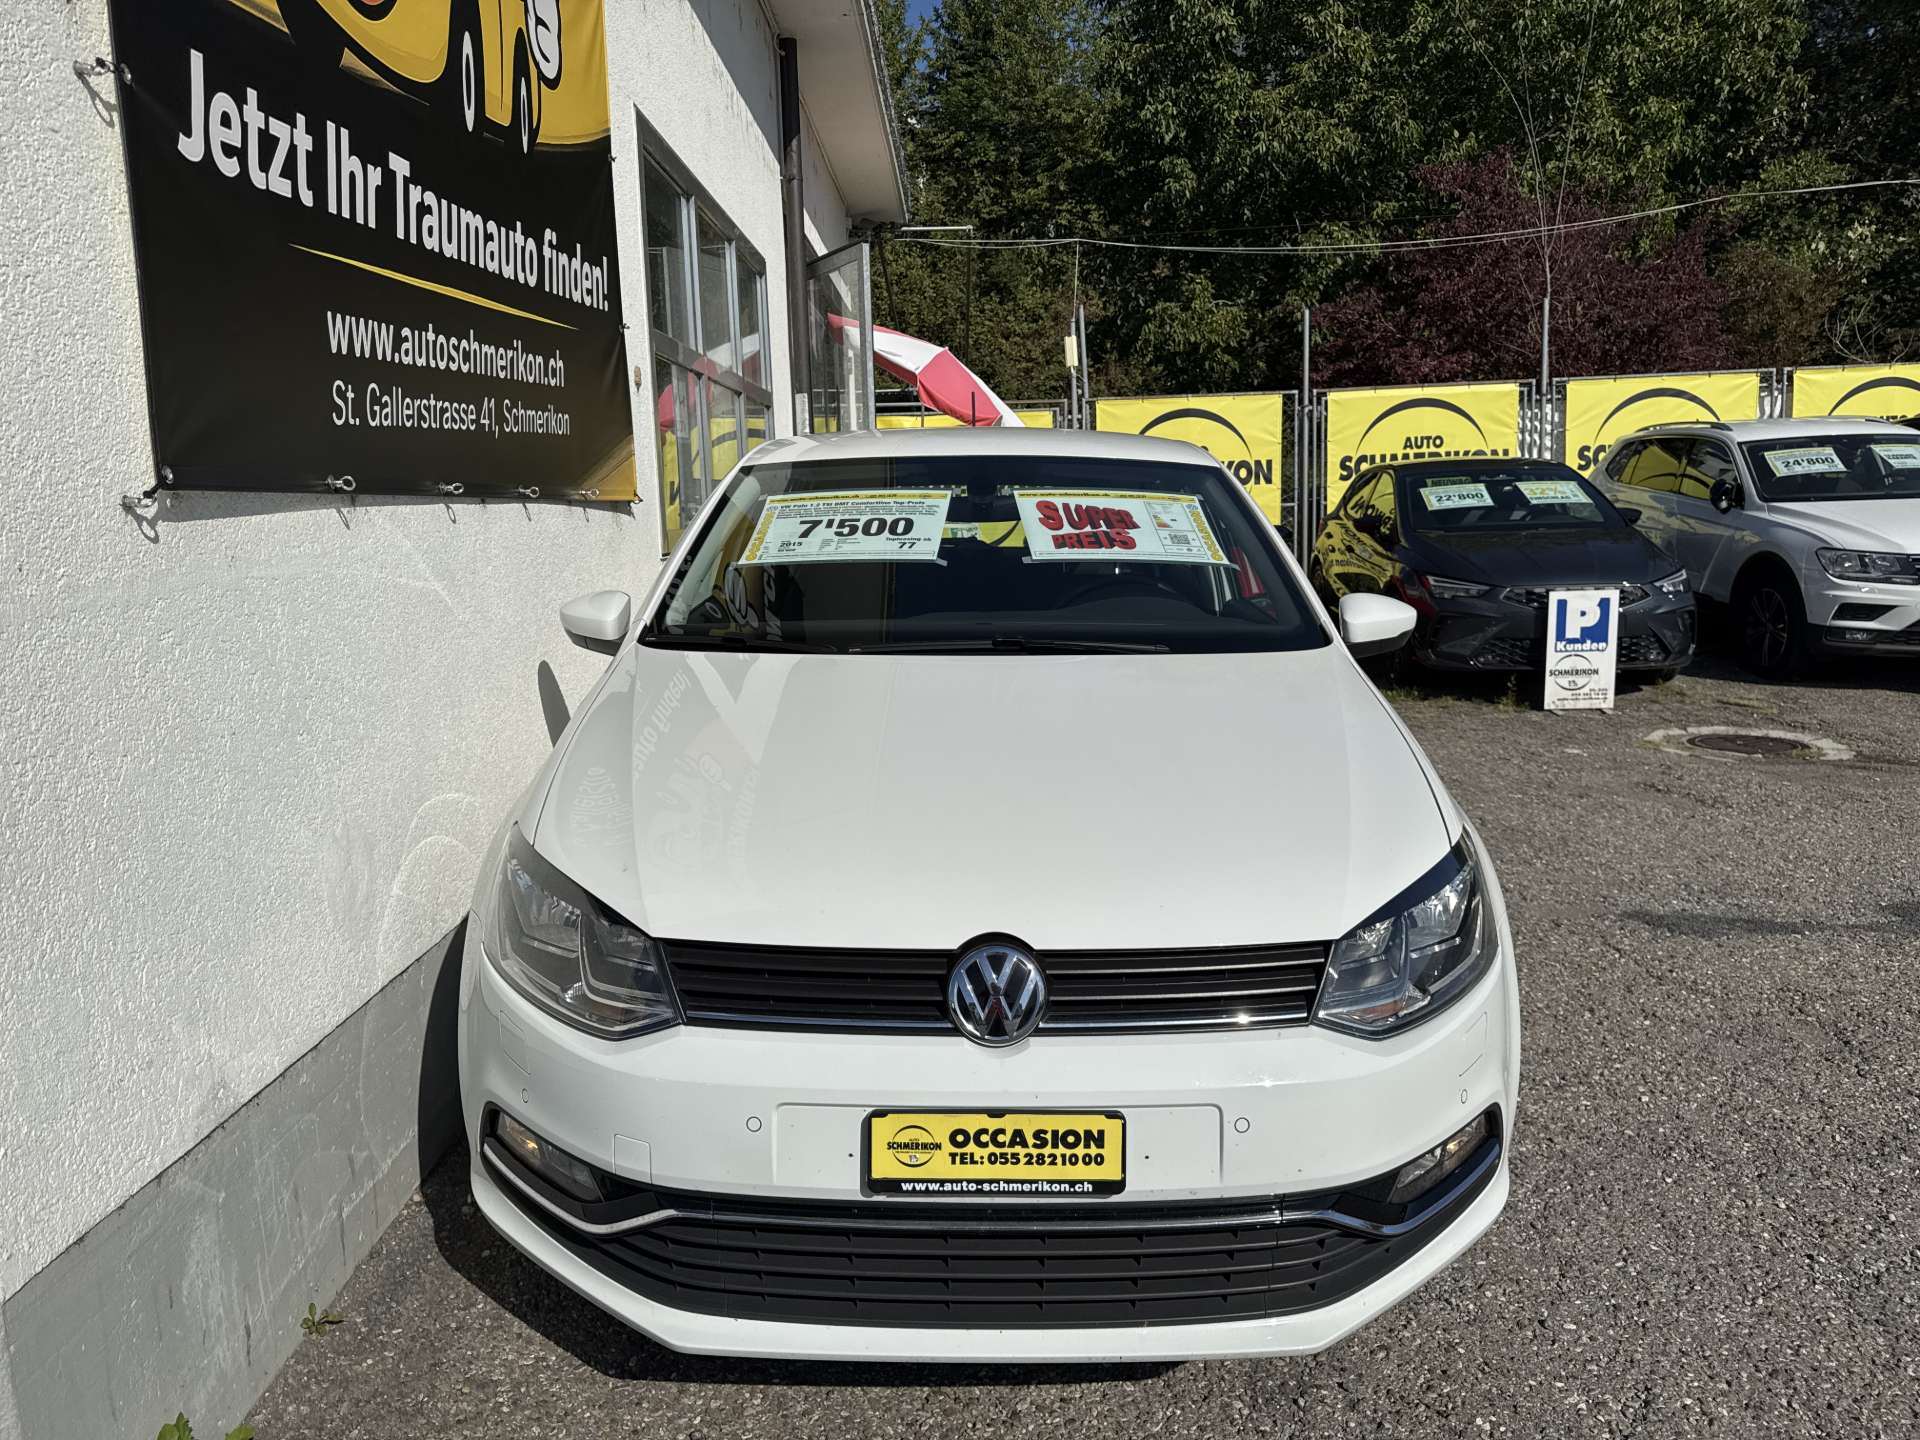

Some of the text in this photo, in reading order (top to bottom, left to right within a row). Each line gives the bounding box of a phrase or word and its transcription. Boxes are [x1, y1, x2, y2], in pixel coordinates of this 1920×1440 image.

[177, 48, 609, 312] Jetzt Ihr Traumauto finden!
[327, 310, 565, 388] www.autoschmerikon.ch
[332, 379, 570, 439] St. Gallerstrasse 41, Schmerikon
[1403, 435, 1444, 450] AUTO
[1782, 456, 1835, 469] 24'800
[1435, 492, 1484, 502] 22'800
[1036, 500, 1142, 531] SUPER
[799, 517, 915, 539] 7'500
[898, 541, 917, 549] 77
[1052, 527, 1137, 550] PREIS
[1556, 640, 1607, 652] Kunden
[1549, 667, 1599, 677] SCHMERIKON
[887, 1141, 942, 1151] SCHMERIKON
[948, 1128, 1105, 1149] OCCASION
[901, 1180, 1093, 1193] www.auto-schmerikon.ch
